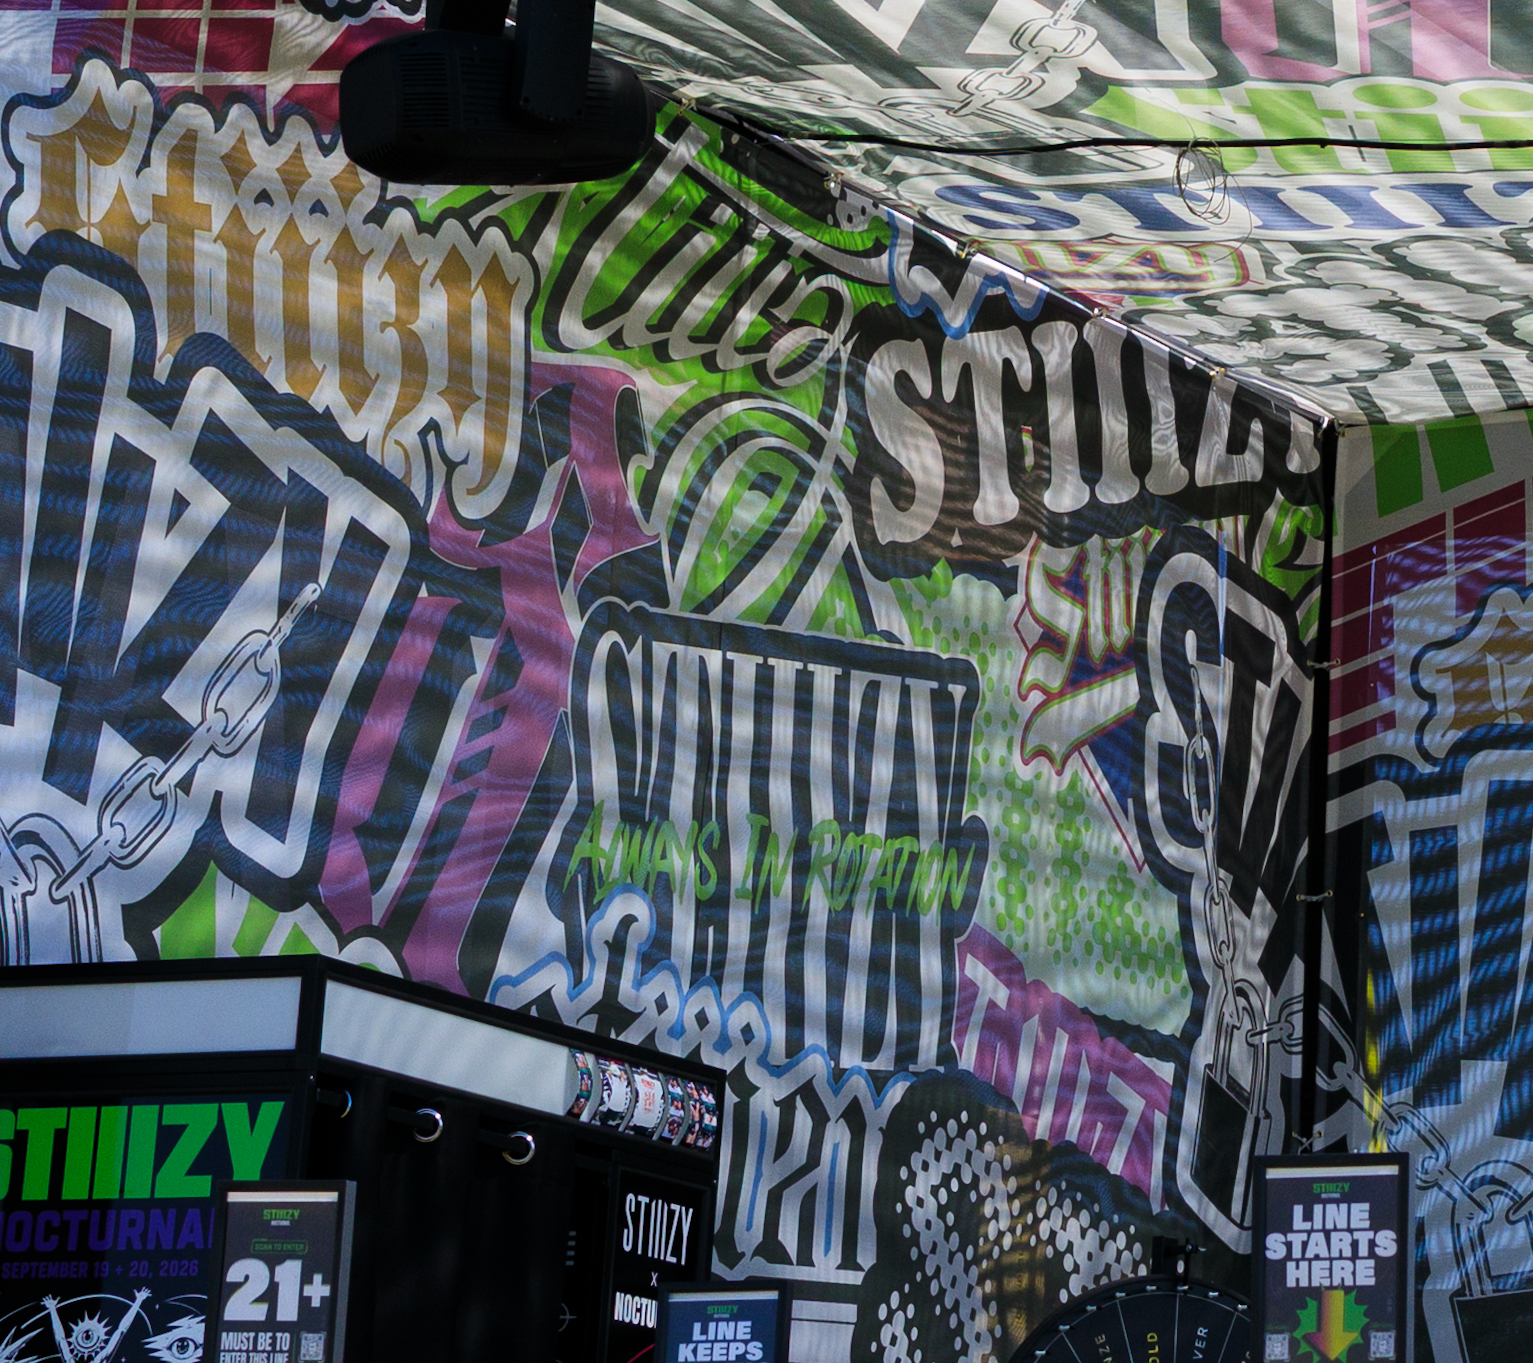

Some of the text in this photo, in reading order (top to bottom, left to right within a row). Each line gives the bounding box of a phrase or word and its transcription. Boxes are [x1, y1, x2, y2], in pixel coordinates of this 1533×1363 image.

[735, 813, 798, 914] IN
[801, 819, 975, 925] ROTATION
[622, 1192, 694, 1267] STIIIZY
[1292, 1202, 1371, 1231] LINE
[1264, 1229, 1398, 1260] STARTS
[0, 1261, 89, 1281] SEPTEMBER
[93, 1260, 109, 1278] 19
[158, 1259, 199, 1278] 2026
[1286, 1259, 1376, 1288] HERE
[223, 1257, 331, 1322] 21+
[614, 1290, 659, 1329] NOCTU
[220, 1331, 291, 1351] MUST BE TO
[692, 1320, 753, 1342] LINE
[677, 1341, 764, 1363] KEEPS
